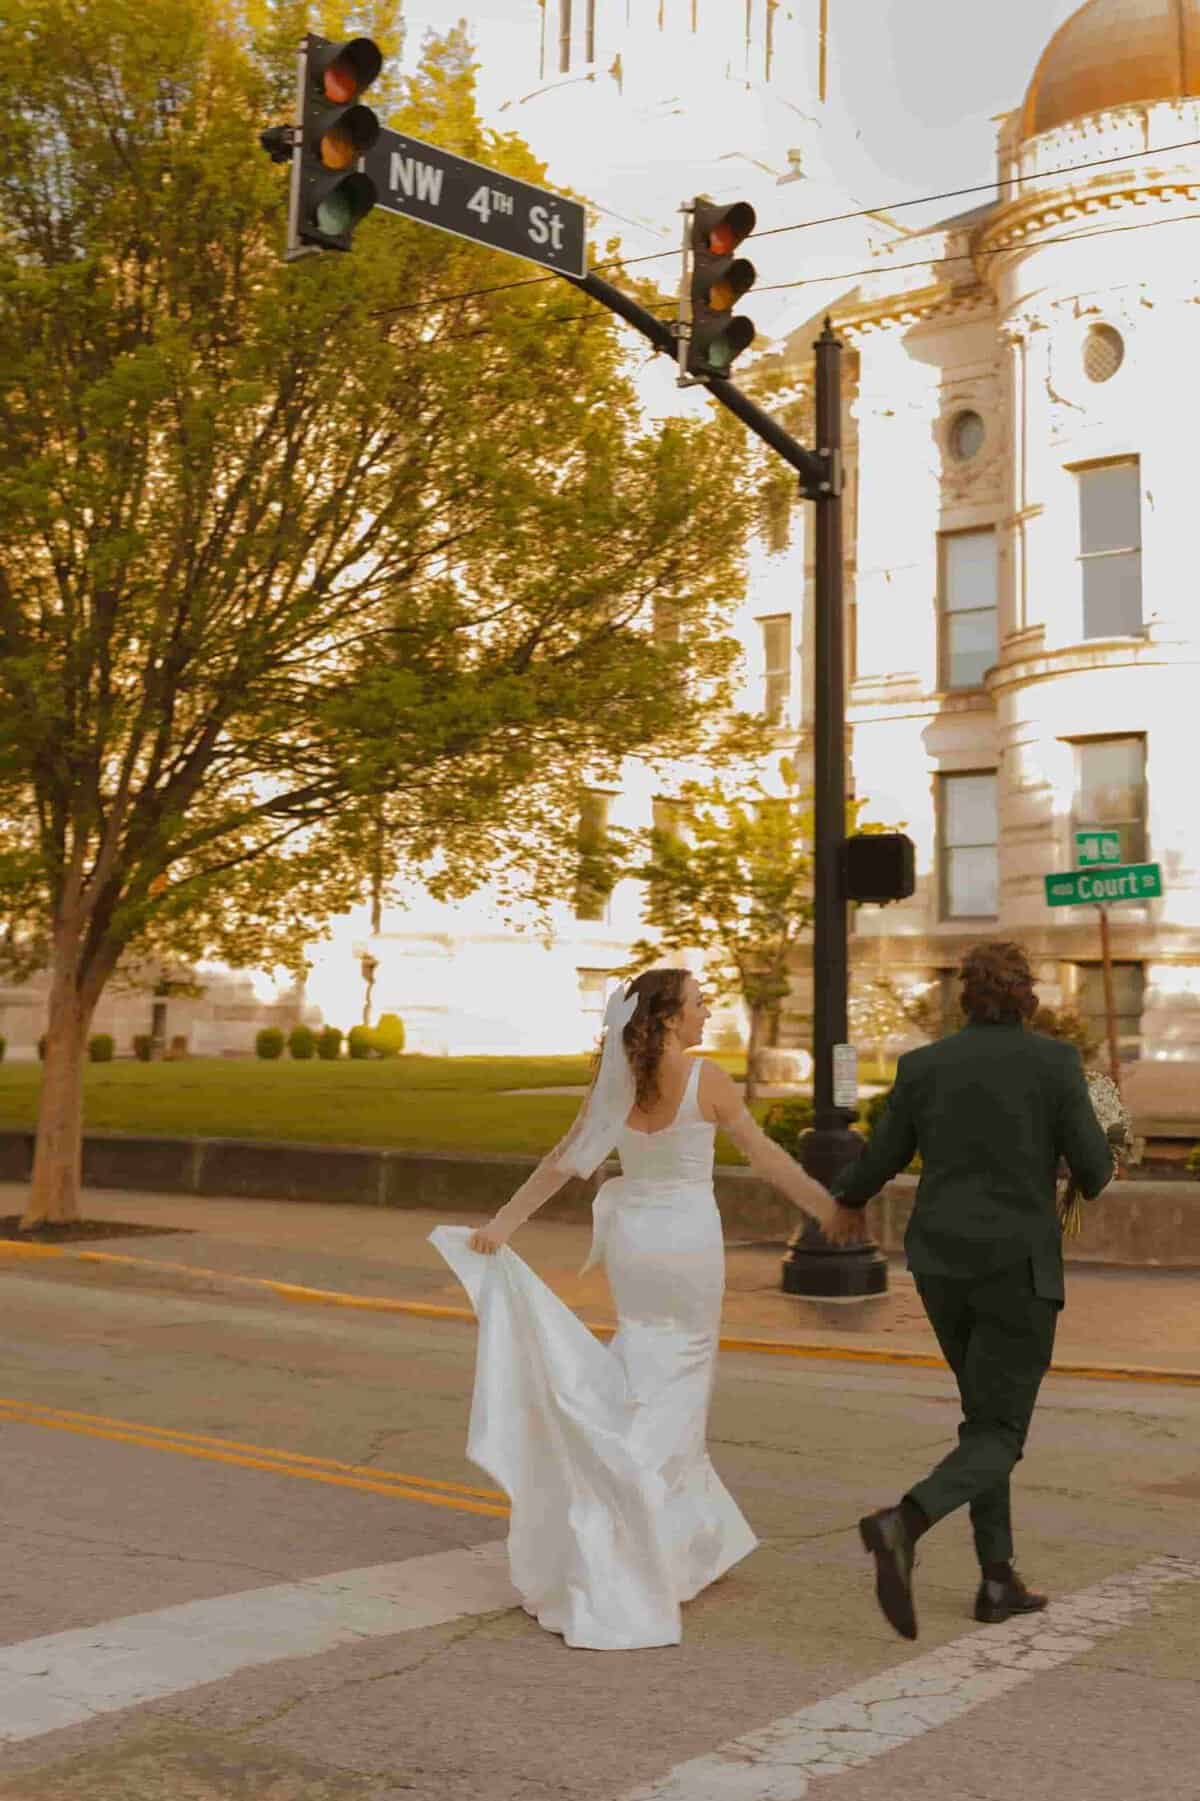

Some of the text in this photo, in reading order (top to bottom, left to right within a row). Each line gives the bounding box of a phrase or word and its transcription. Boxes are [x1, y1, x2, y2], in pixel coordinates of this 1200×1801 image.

[389, 152, 564, 249] NW 4TH St
[1078, 871, 1138, 899] Court
